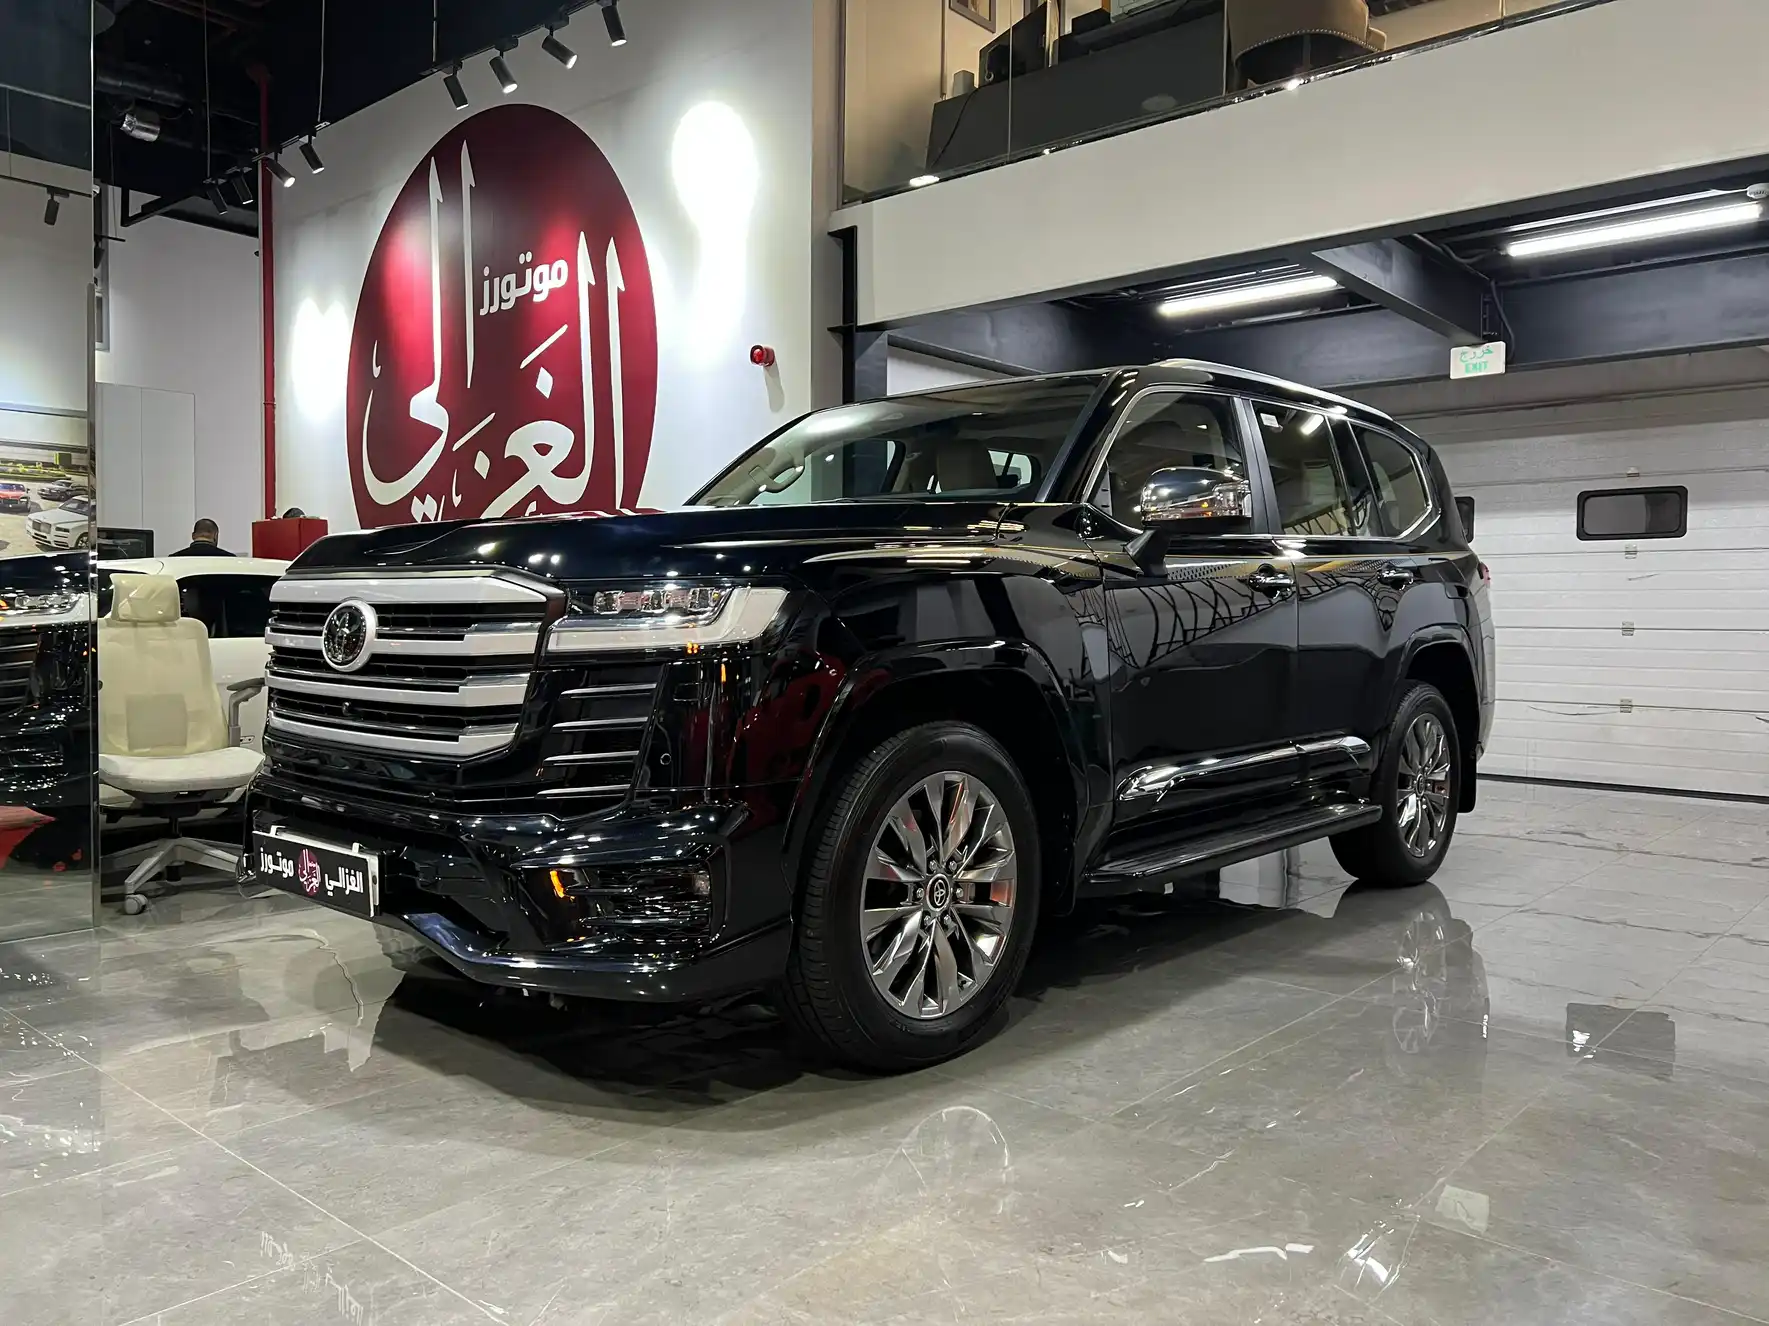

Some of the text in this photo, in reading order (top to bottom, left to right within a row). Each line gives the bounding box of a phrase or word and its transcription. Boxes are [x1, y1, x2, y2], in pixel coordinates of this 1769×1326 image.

[479, 250, 569, 316] موتورز
[1460, 345, 1493, 362] خروج
[1465, 360, 1488, 375] EXIT
[259, 847, 364, 897] الغزالي موتورز
